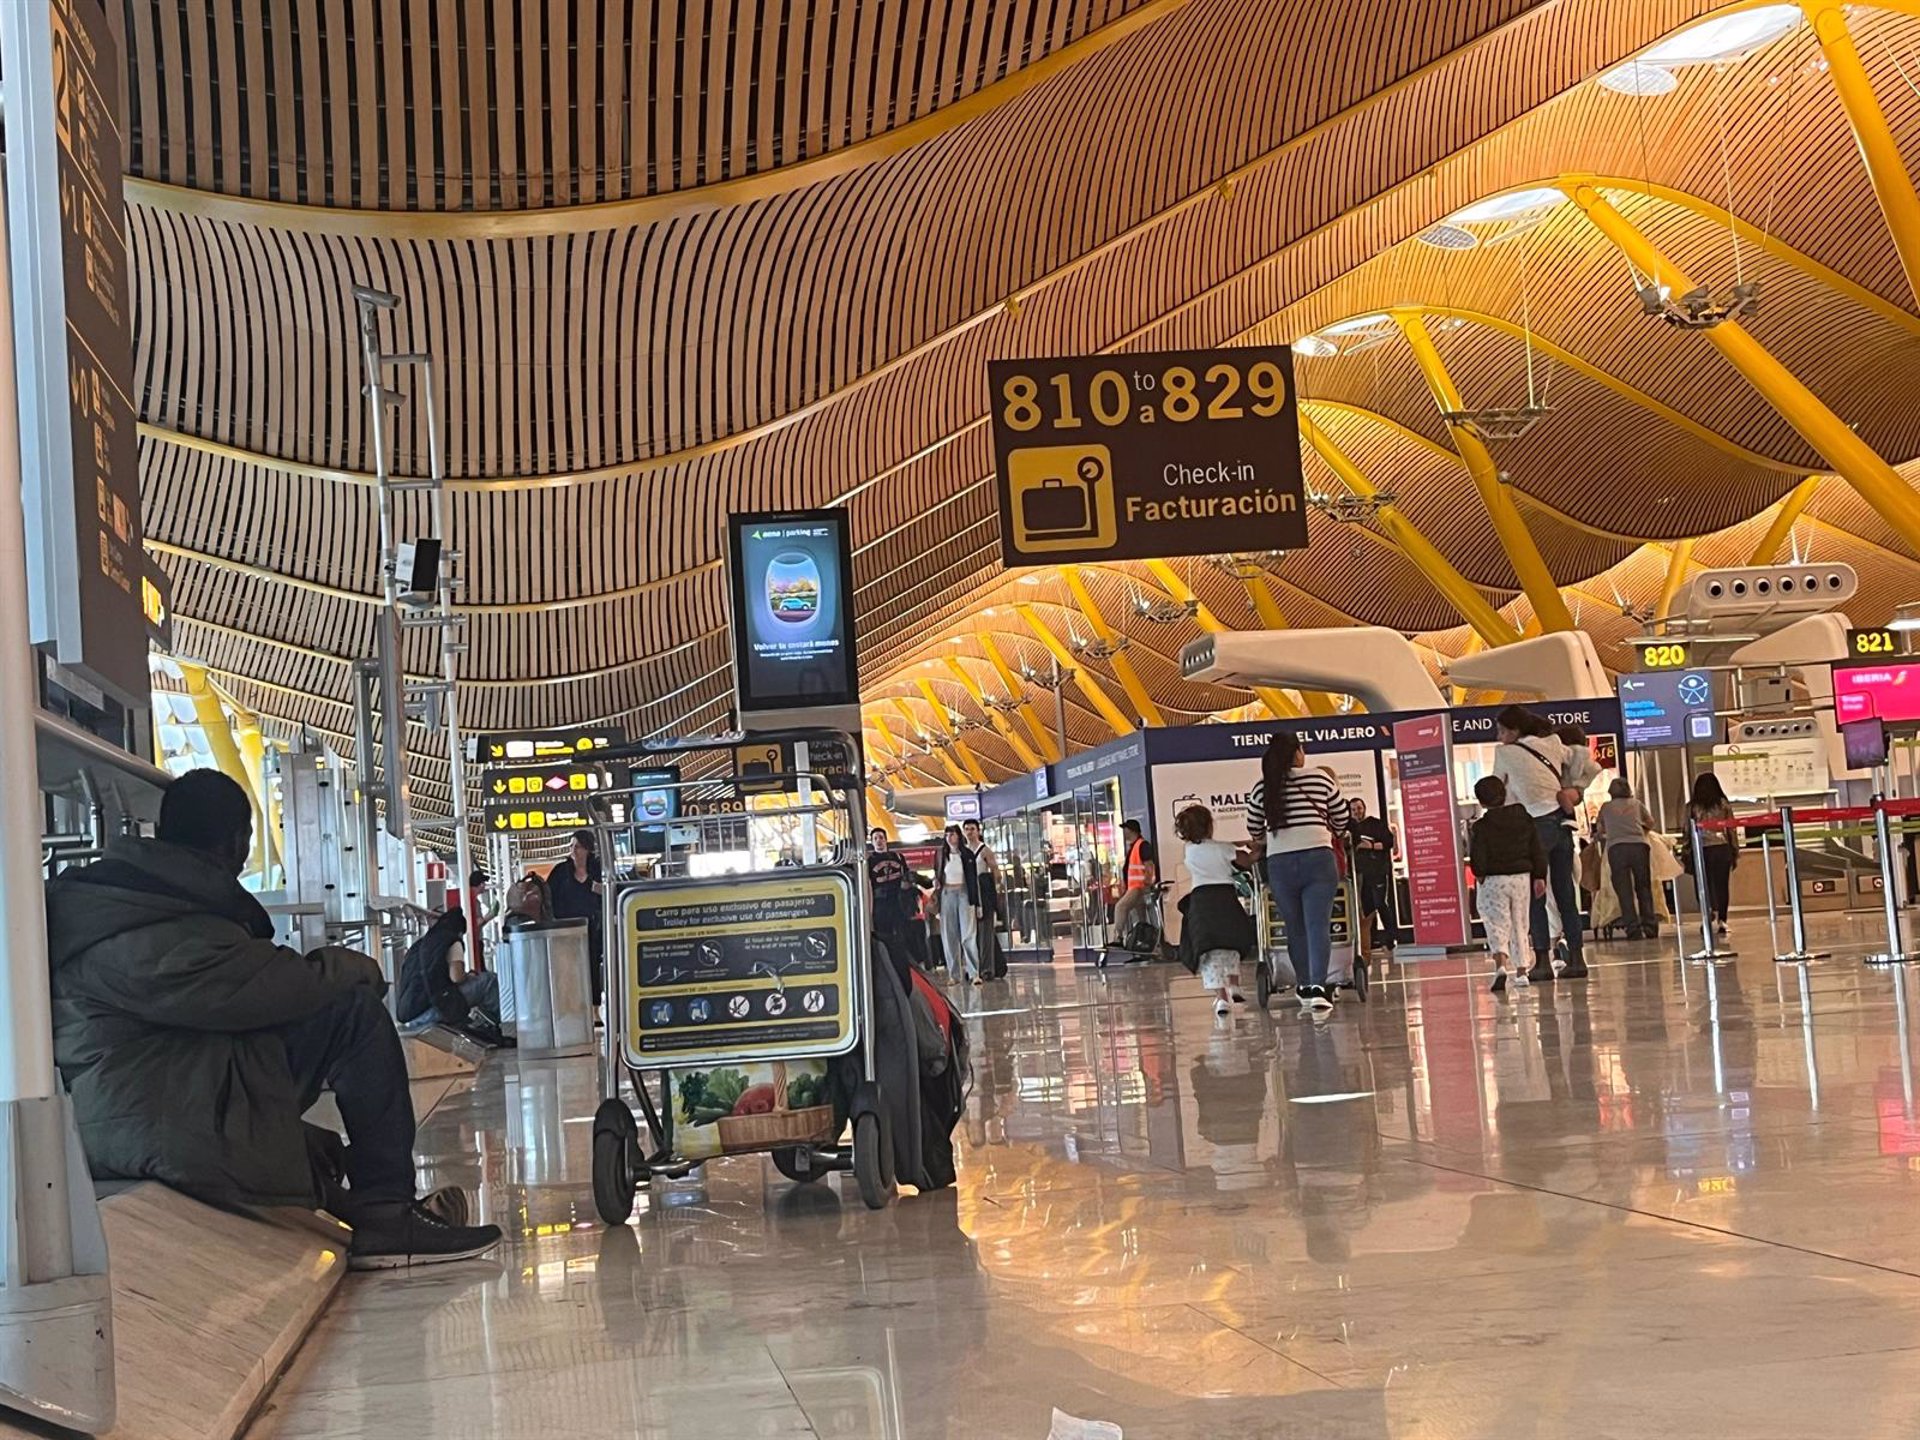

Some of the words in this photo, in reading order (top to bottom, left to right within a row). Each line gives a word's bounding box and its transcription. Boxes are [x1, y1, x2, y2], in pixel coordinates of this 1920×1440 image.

[1133, 370, 1156, 392] to
[1003, 369, 1132, 432] 810
[1162, 361, 1286, 423] 829
[1139, 403, 1156, 424] a
[1162, 460, 1256, 488] Check-in
[1125, 488, 1298, 523] Facturación
[786, 528, 811, 538] parking
[1856, 632, 1894, 653] 821
[1644, 645, 1686, 667] 820
[1851, 672, 1892, 684] IBERIA
[1463, 718, 1493, 731] AND
[1547, 711, 1591, 725] STORE
[1231, 733, 1273, 747] TIEND
[1314, 725, 1376, 742] VIAJERO
[1210, 792, 1251, 807] MALE
[654, 908, 679, 918] Carro
[681, 907, 700, 916] para
[702, 905, 718, 913] uso
[720, 901, 759, 913] exclusivo
[760, 900, 772, 909] de
[774, 897, 816, 909] pasajeros
[663, 918, 688, 927] Trolley
[689, 917, 700, 925] for
[702, 914, 738, 923] exclusive
[755, 911, 764, 919] of
[765, 909, 809, 920] passengers
